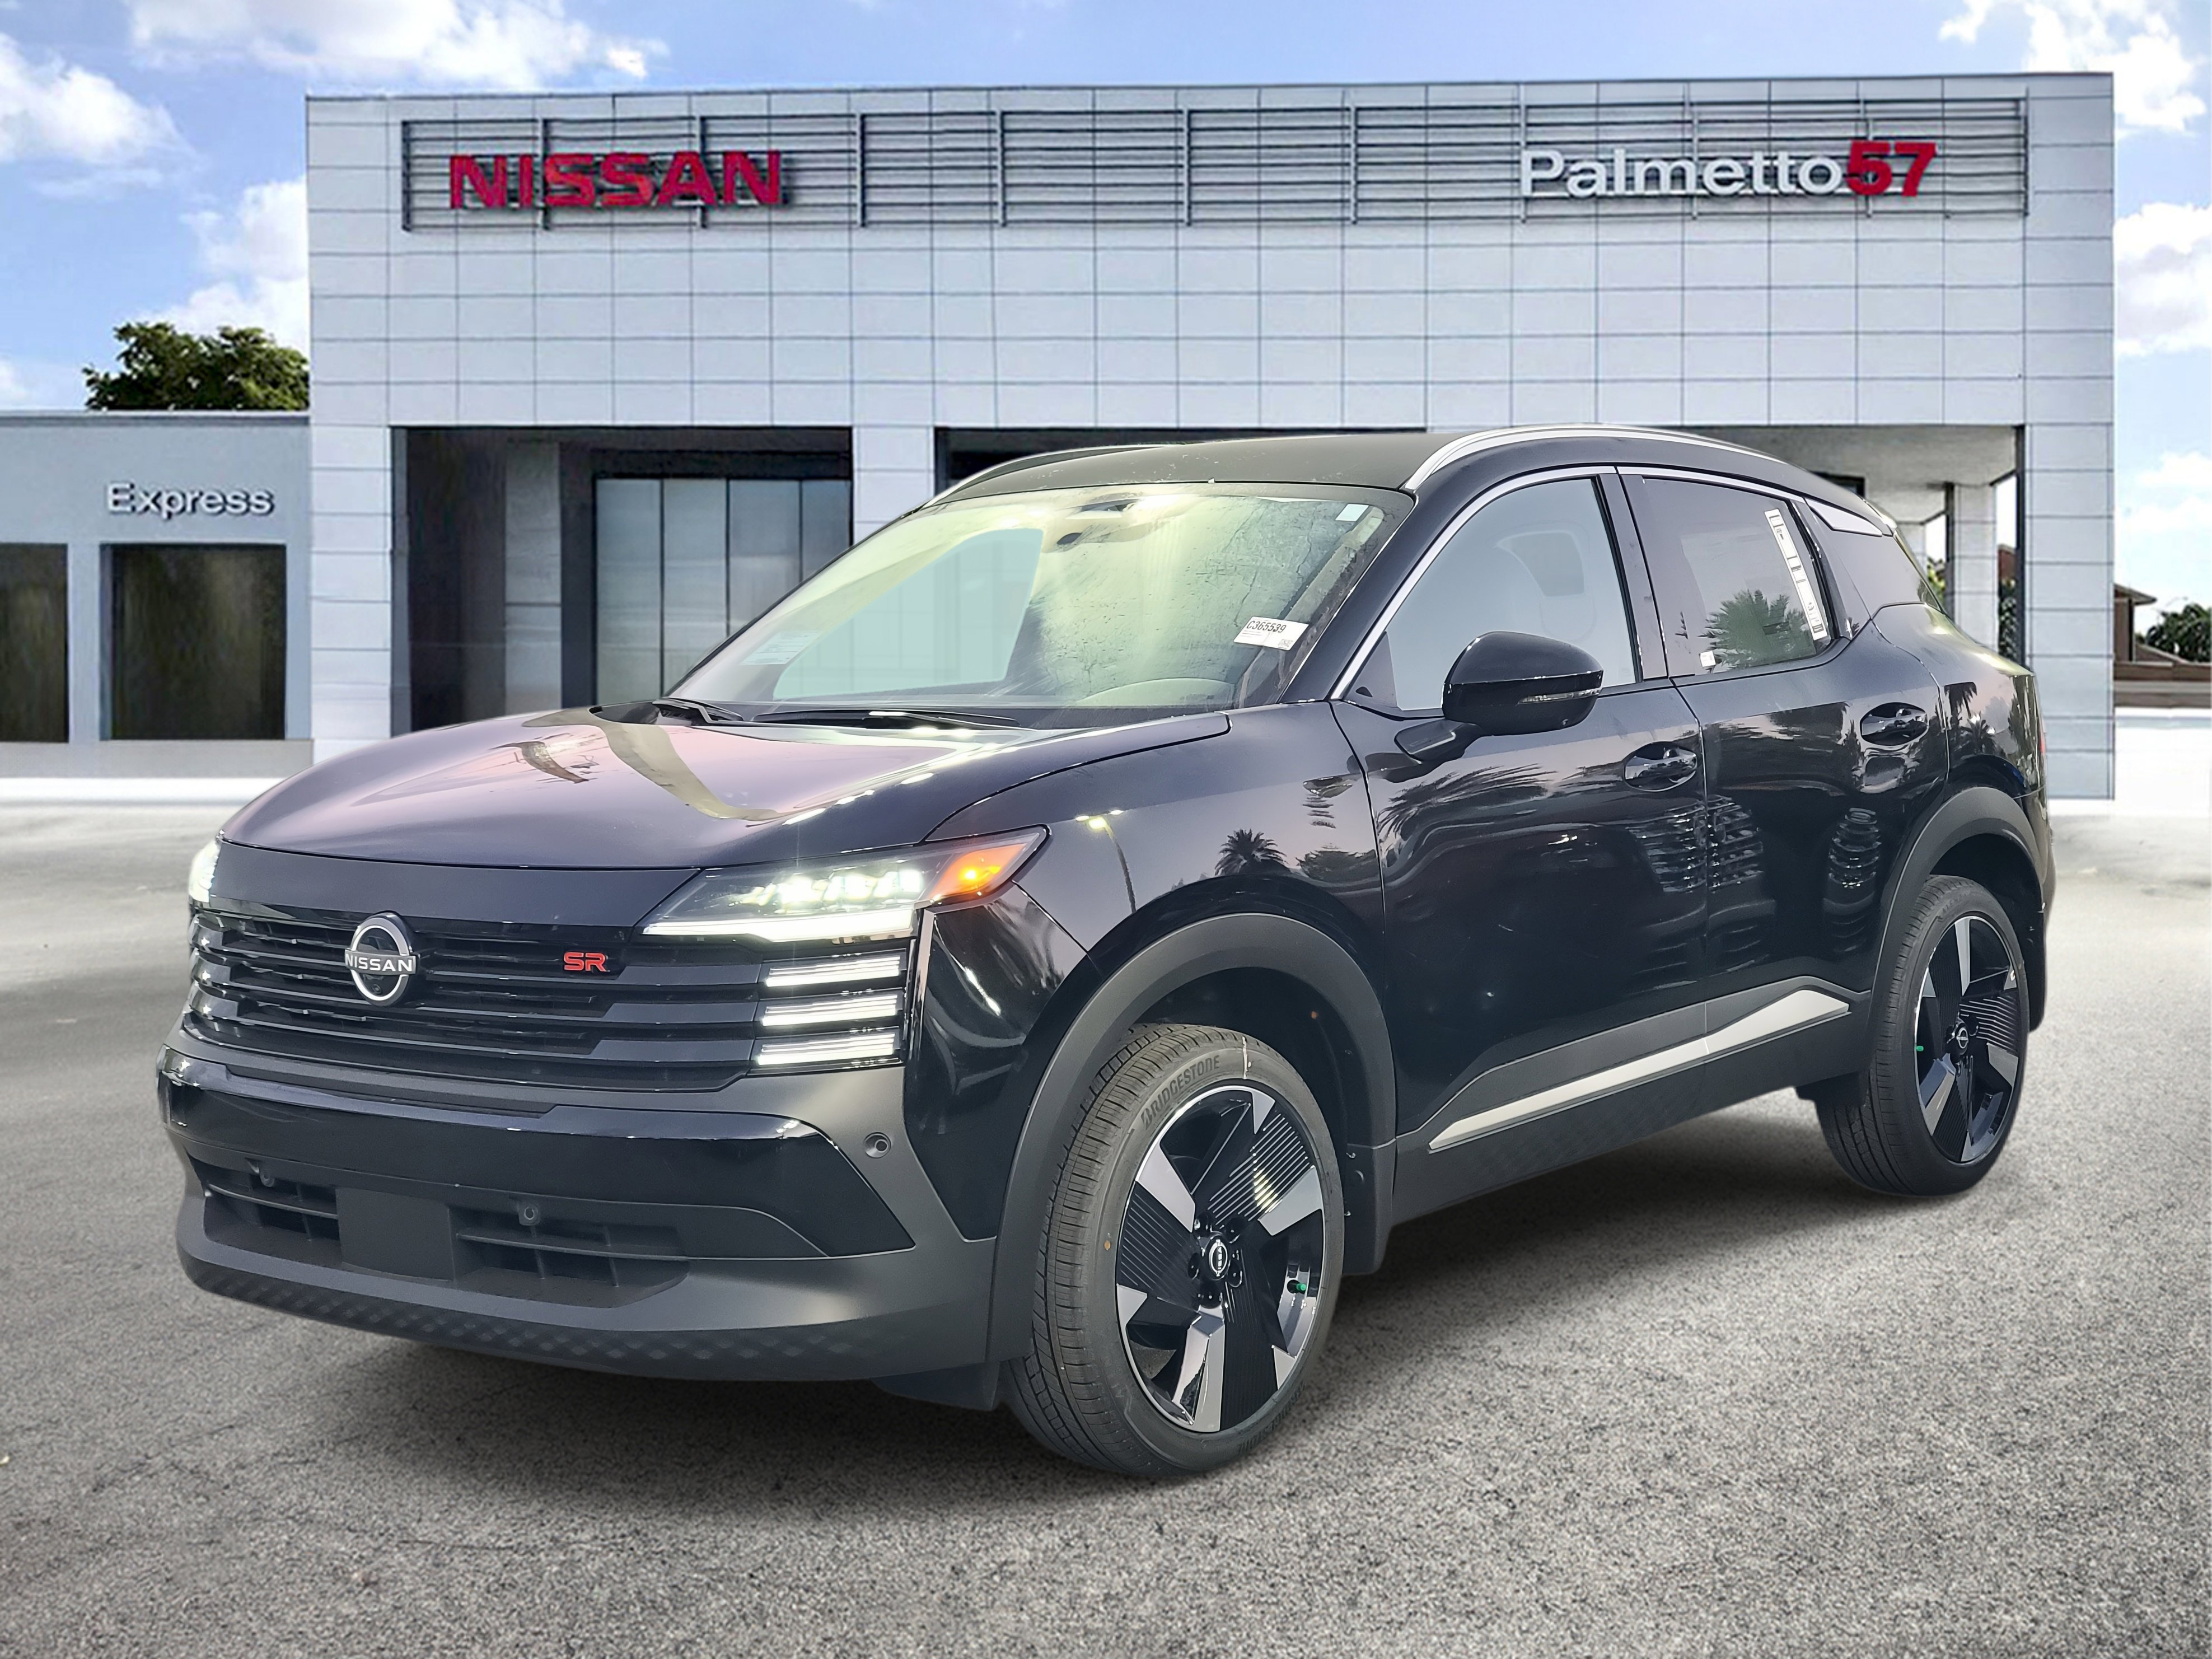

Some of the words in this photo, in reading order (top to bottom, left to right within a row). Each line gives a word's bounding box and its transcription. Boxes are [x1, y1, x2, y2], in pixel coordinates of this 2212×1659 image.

[450, 151, 780, 209] NISSAN
[109, 483, 274, 520] Express
[1246, 620, 1287, 633] C365539
[345, 954, 413, 971] NISSAN
[564, 952, 606, 971] SR
[1140, 1055, 1219, 1130] BRIDGESTONE
